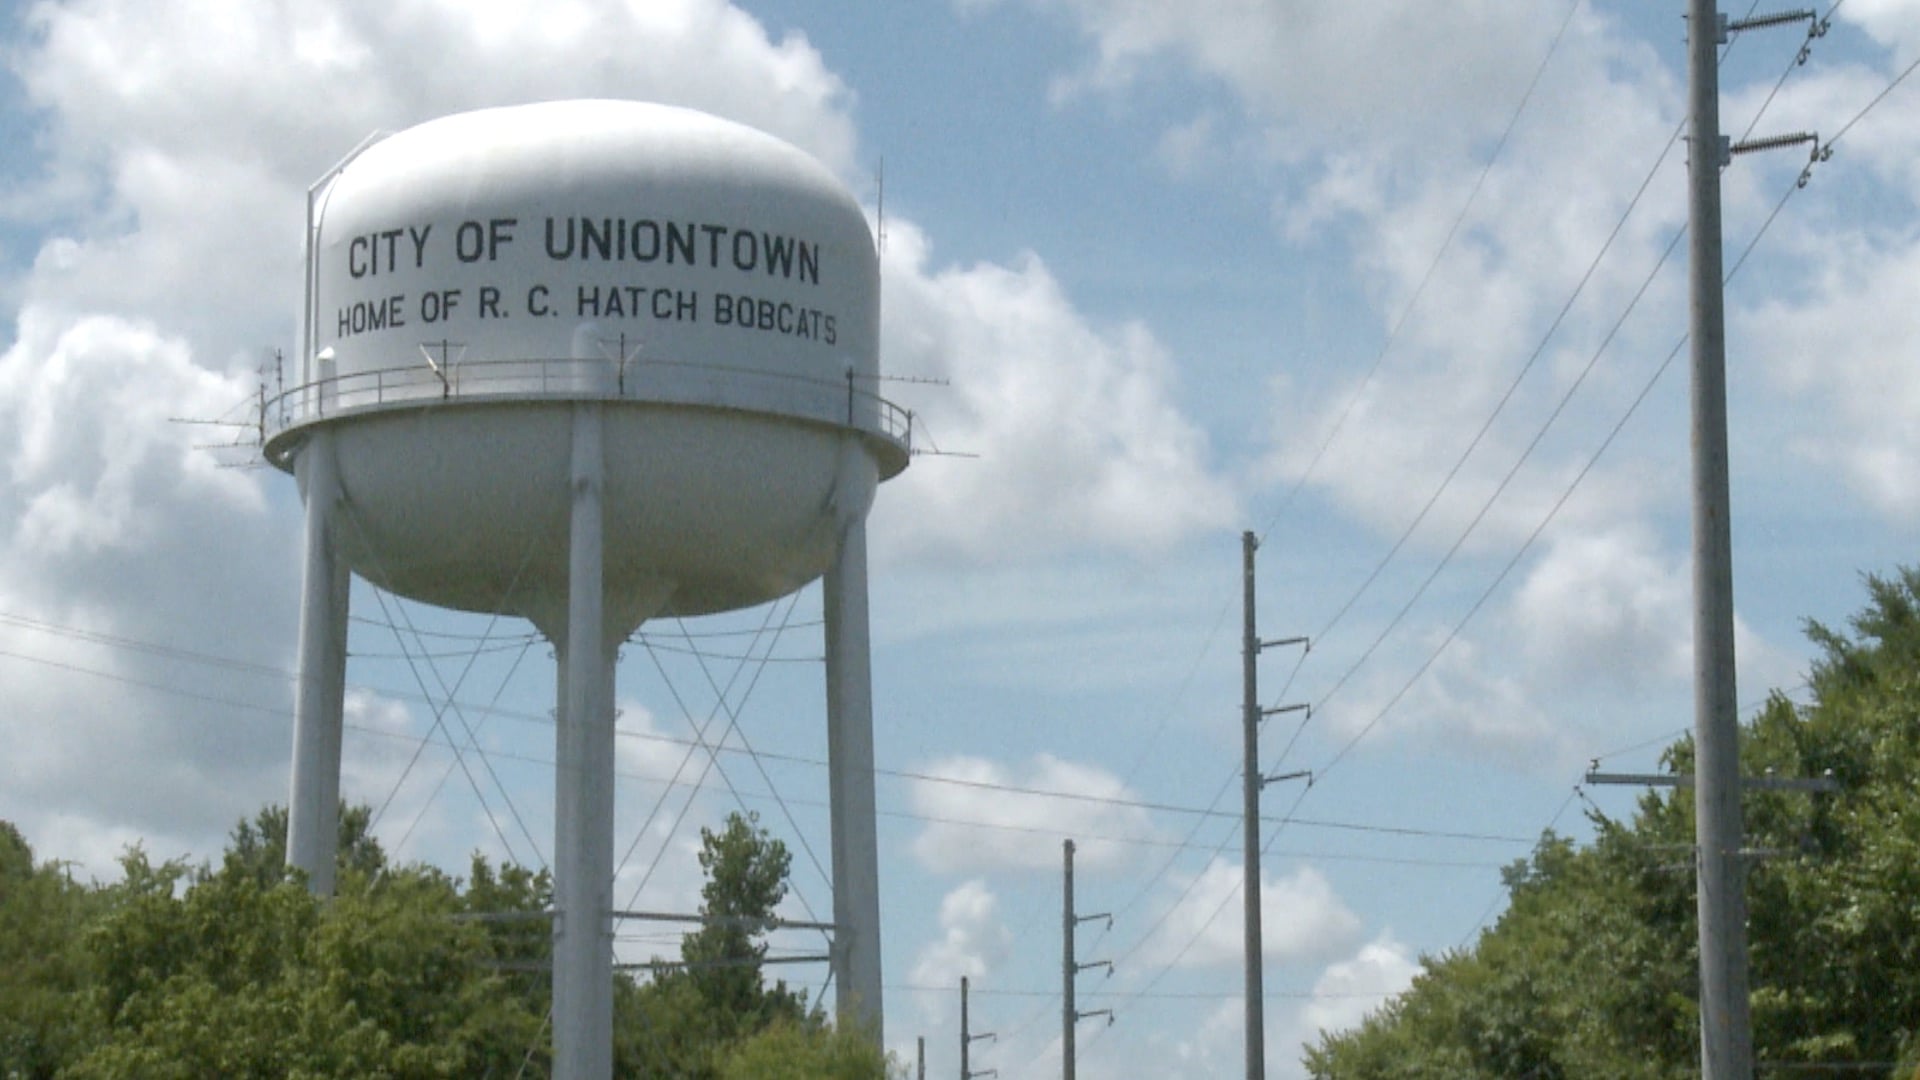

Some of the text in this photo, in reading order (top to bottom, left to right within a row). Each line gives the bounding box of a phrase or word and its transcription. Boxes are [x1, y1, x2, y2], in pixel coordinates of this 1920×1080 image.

[349, 217, 819, 285] CITY OF UNIONTOWN
[337, 284, 837, 346] HOME OF R. C. HATCH BOBCATS
